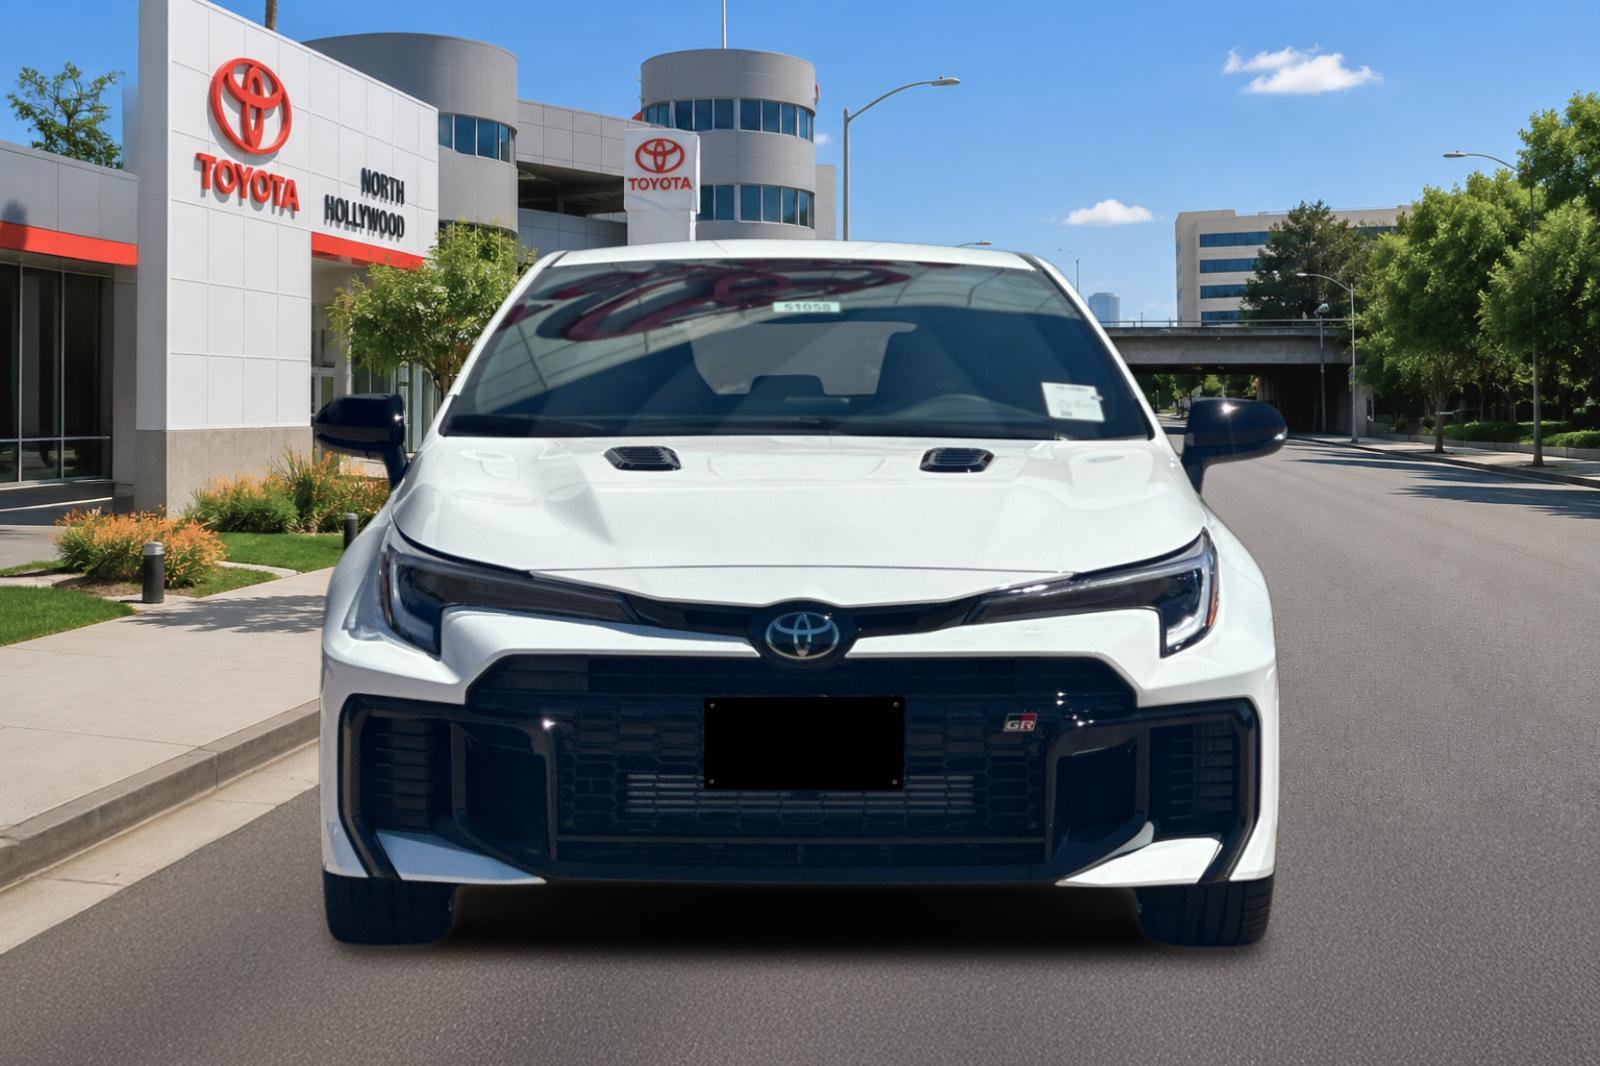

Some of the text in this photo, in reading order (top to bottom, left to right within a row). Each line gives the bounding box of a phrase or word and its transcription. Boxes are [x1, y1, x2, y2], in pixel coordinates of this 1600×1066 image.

[196, 153, 300, 212] TOYOTA
[361, 168, 405, 205] NORTH
[628, 177, 693, 191] TOYOTA
[324, 194, 405, 239] HOLLYWOOD
[1006, 720, 1034, 730] GR
